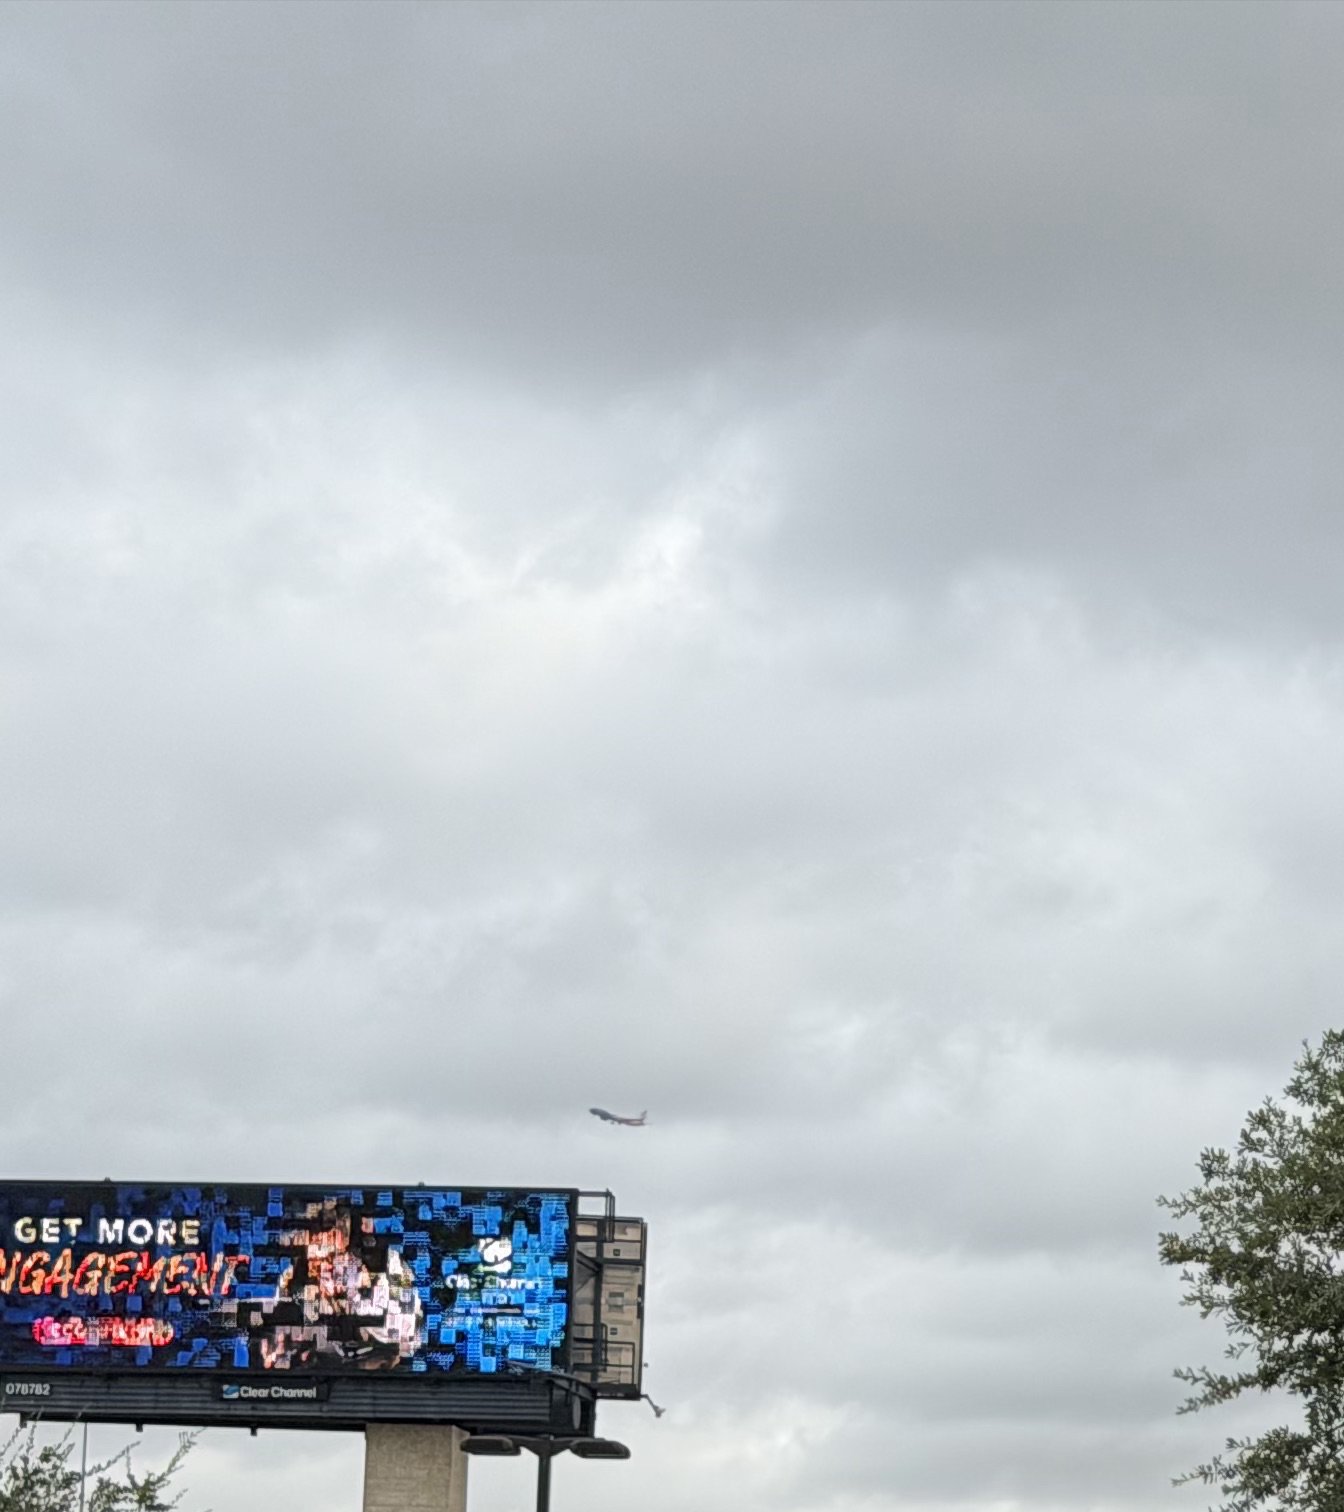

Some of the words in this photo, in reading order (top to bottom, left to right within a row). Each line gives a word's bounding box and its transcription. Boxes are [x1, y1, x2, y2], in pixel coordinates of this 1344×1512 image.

[14, 1216, 83, 1244] GET
[97, 1218, 200, 1245] MORE
[240, 1385, 270, 1398] Clear
[270, 1386, 317, 1399] Channel
